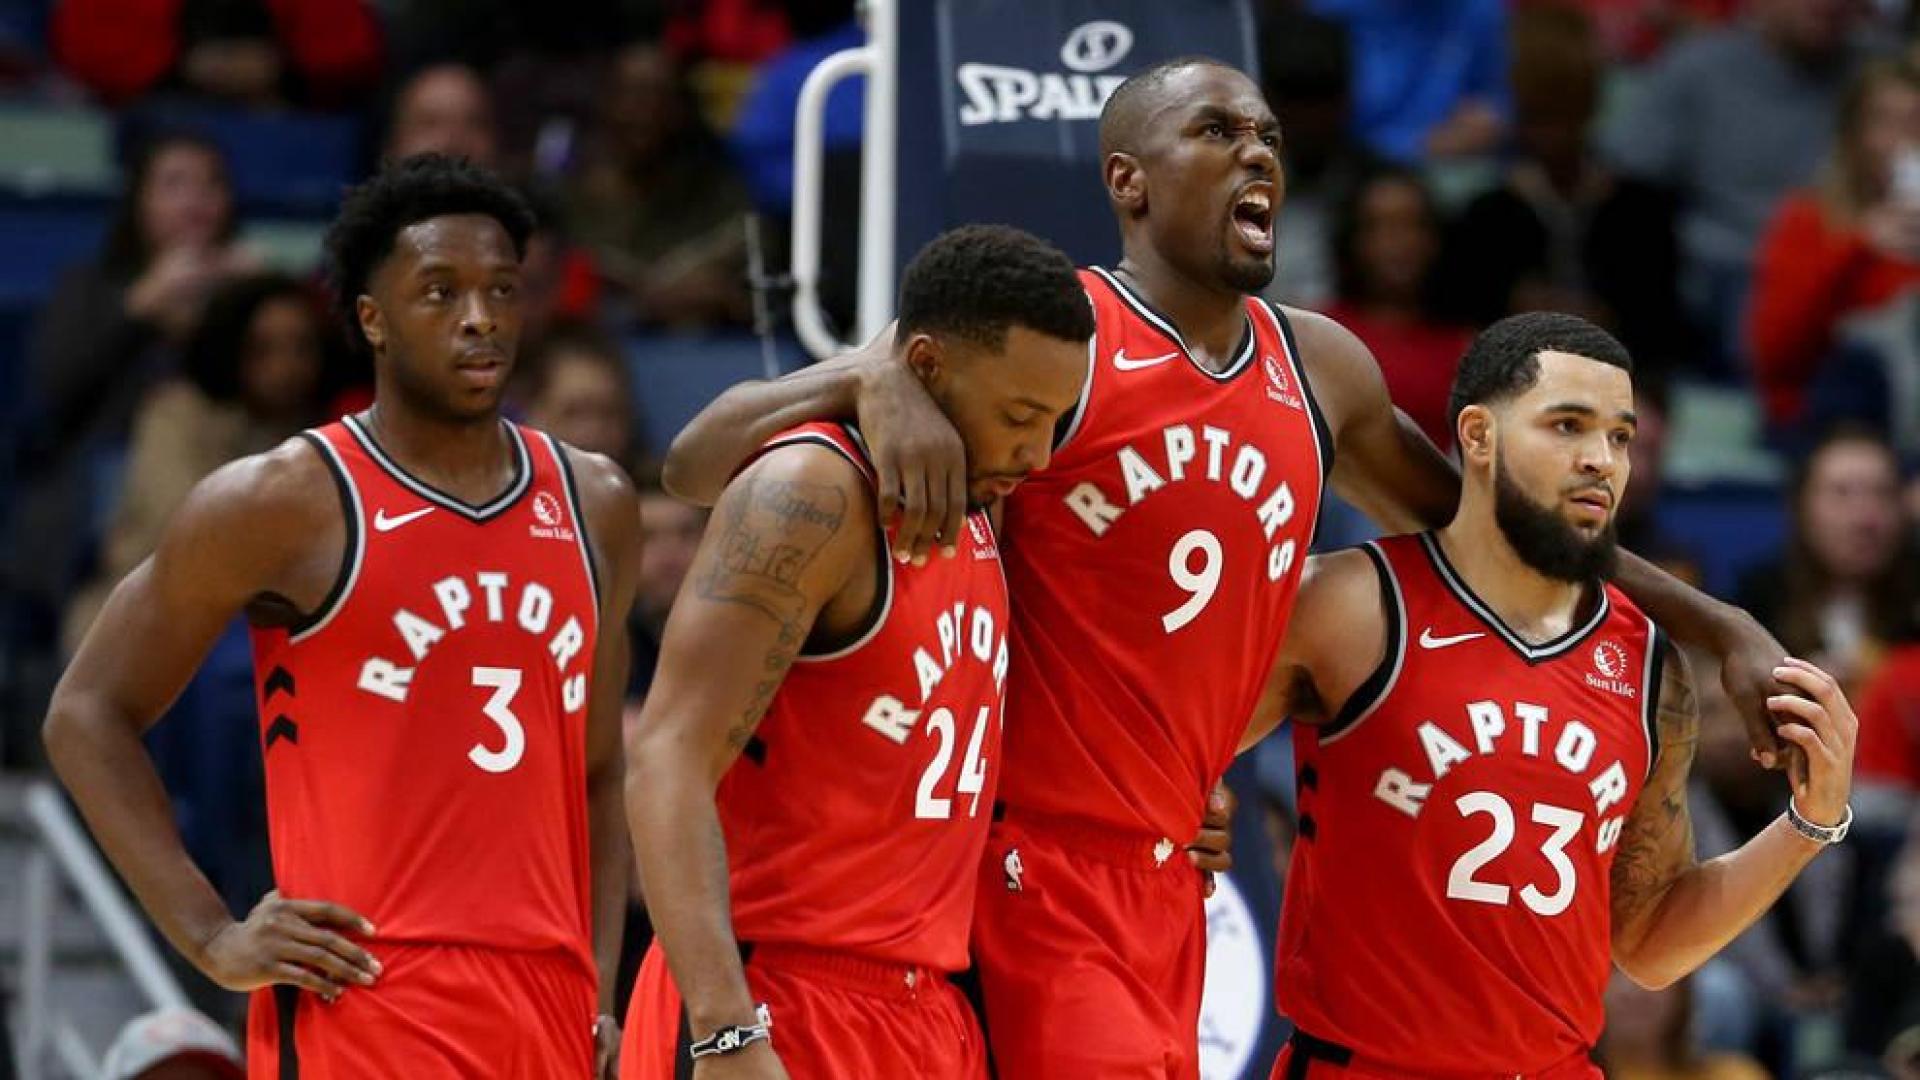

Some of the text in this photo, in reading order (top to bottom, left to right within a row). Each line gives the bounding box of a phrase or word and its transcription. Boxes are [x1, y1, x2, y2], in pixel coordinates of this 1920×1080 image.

[1063, 423, 1297, 582] RAPTORS
[1161, 528, 1224, 635] 9
[467, 666, 526, 774] 3
[861, 600, 1009, 745] RAPTOR
[1585, 672, 1636, 699] Sun Life
[914, 706, 990, 820] 24
[1373, 699, 1629, 855] RAPTORS
[1446, 790, 1585, 917] 23
